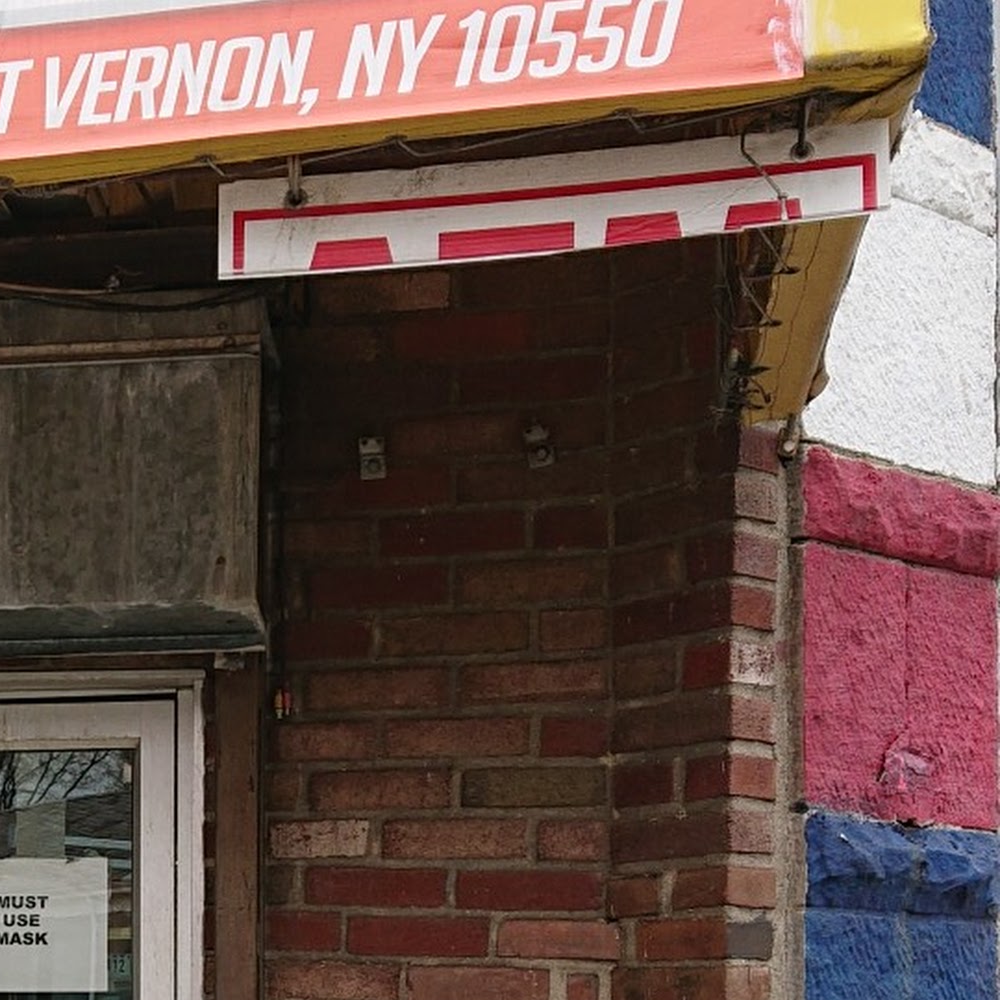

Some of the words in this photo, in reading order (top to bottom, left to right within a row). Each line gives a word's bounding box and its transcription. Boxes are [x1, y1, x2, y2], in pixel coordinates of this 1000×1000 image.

[44, 29, 319, 129] VERNON,
[337, 14, 446, 99] NY
[454, 0, 684, 88] 10550
[3, 913, 41, 928] USE
